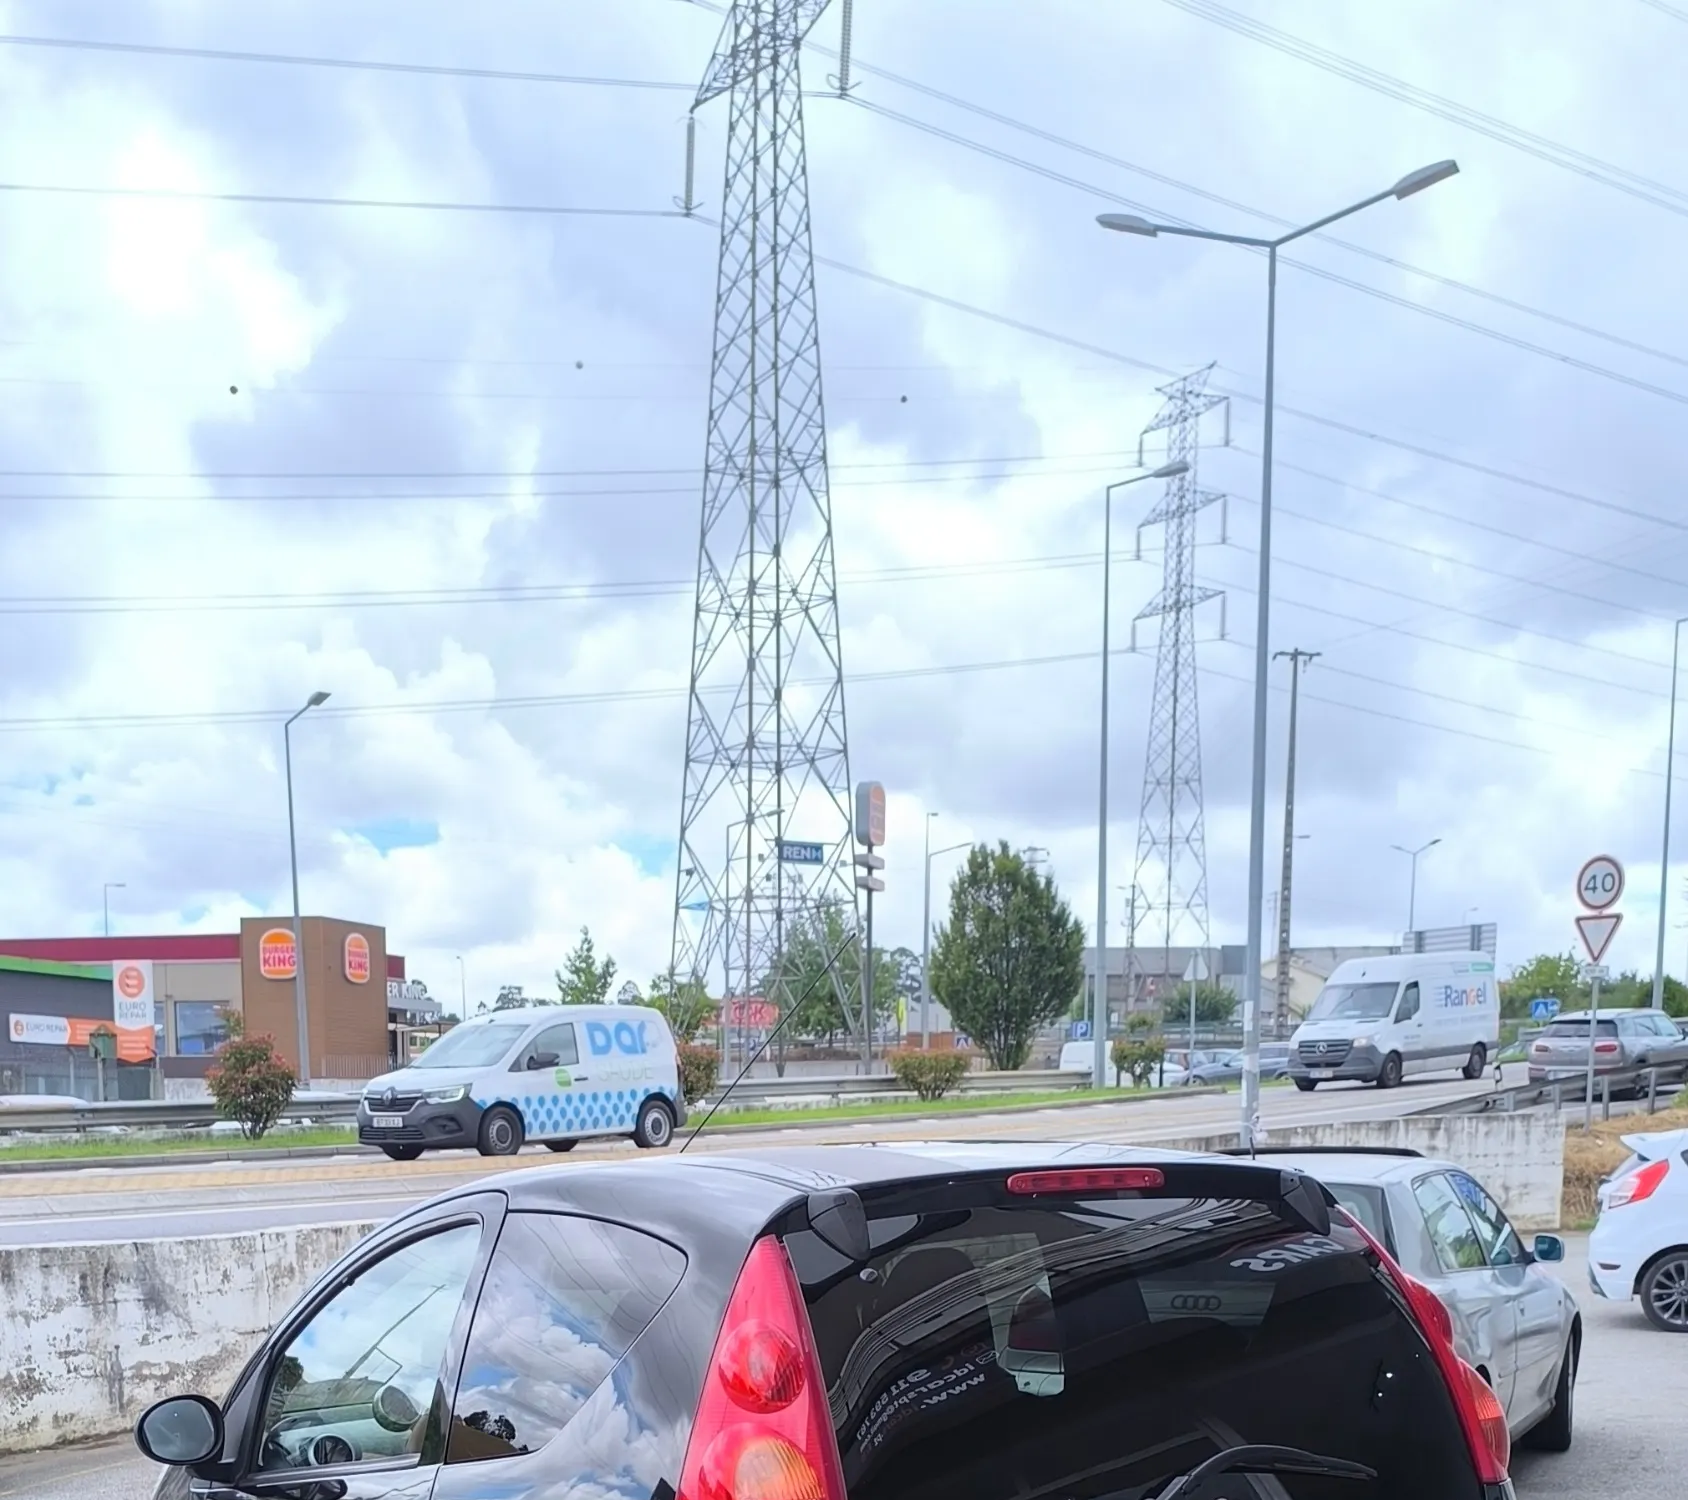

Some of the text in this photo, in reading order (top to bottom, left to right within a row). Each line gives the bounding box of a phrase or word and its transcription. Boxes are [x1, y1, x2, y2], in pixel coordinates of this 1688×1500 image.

[783, 845, 811, 860] REN
[1584, 873, 1616, 895] 40
[263, 954, 296, 968] KING
[348, 959, 368, 972] KING
[119, 1001, 147, 1011] EURO
[1077, 1023, 1085, 1036] P
